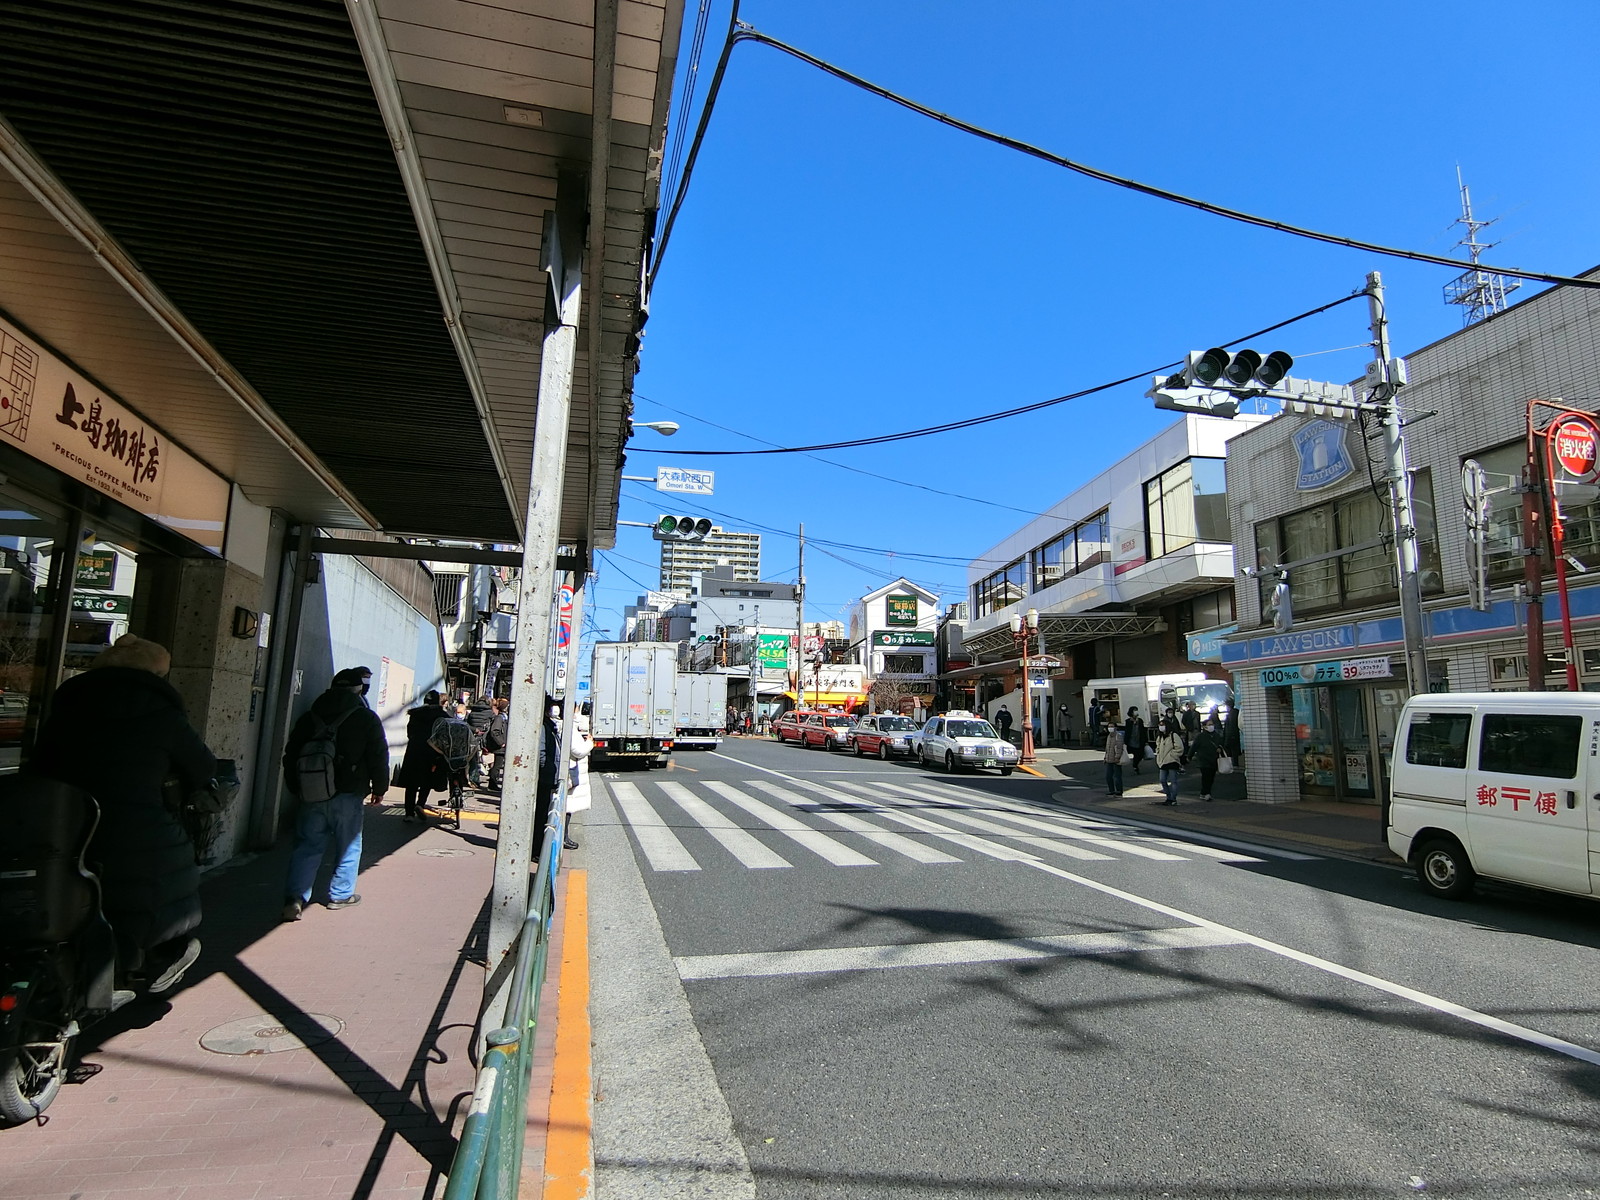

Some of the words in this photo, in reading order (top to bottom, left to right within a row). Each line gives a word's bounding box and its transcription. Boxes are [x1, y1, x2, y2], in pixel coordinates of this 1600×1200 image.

[56, 382, 160, 484] 上島珈琲店
[1298, 422, 1338, 444] LAWSON
[1559, 437, 1595, 461] 消火栓
[94, 466, 119, 486] COFFEE
[660, 471, 711, 485] 大森駅西口
[1301, 460, 1344, 483] STATION
[666, 481, 683, 489] Omori
[1202, 638, 1227, 652] MIST
[1260, 629, 1341, 656] LAWSON
[1262, 670, 1299, 683] 100%の
[1343, 666, 1358, 678] 39
